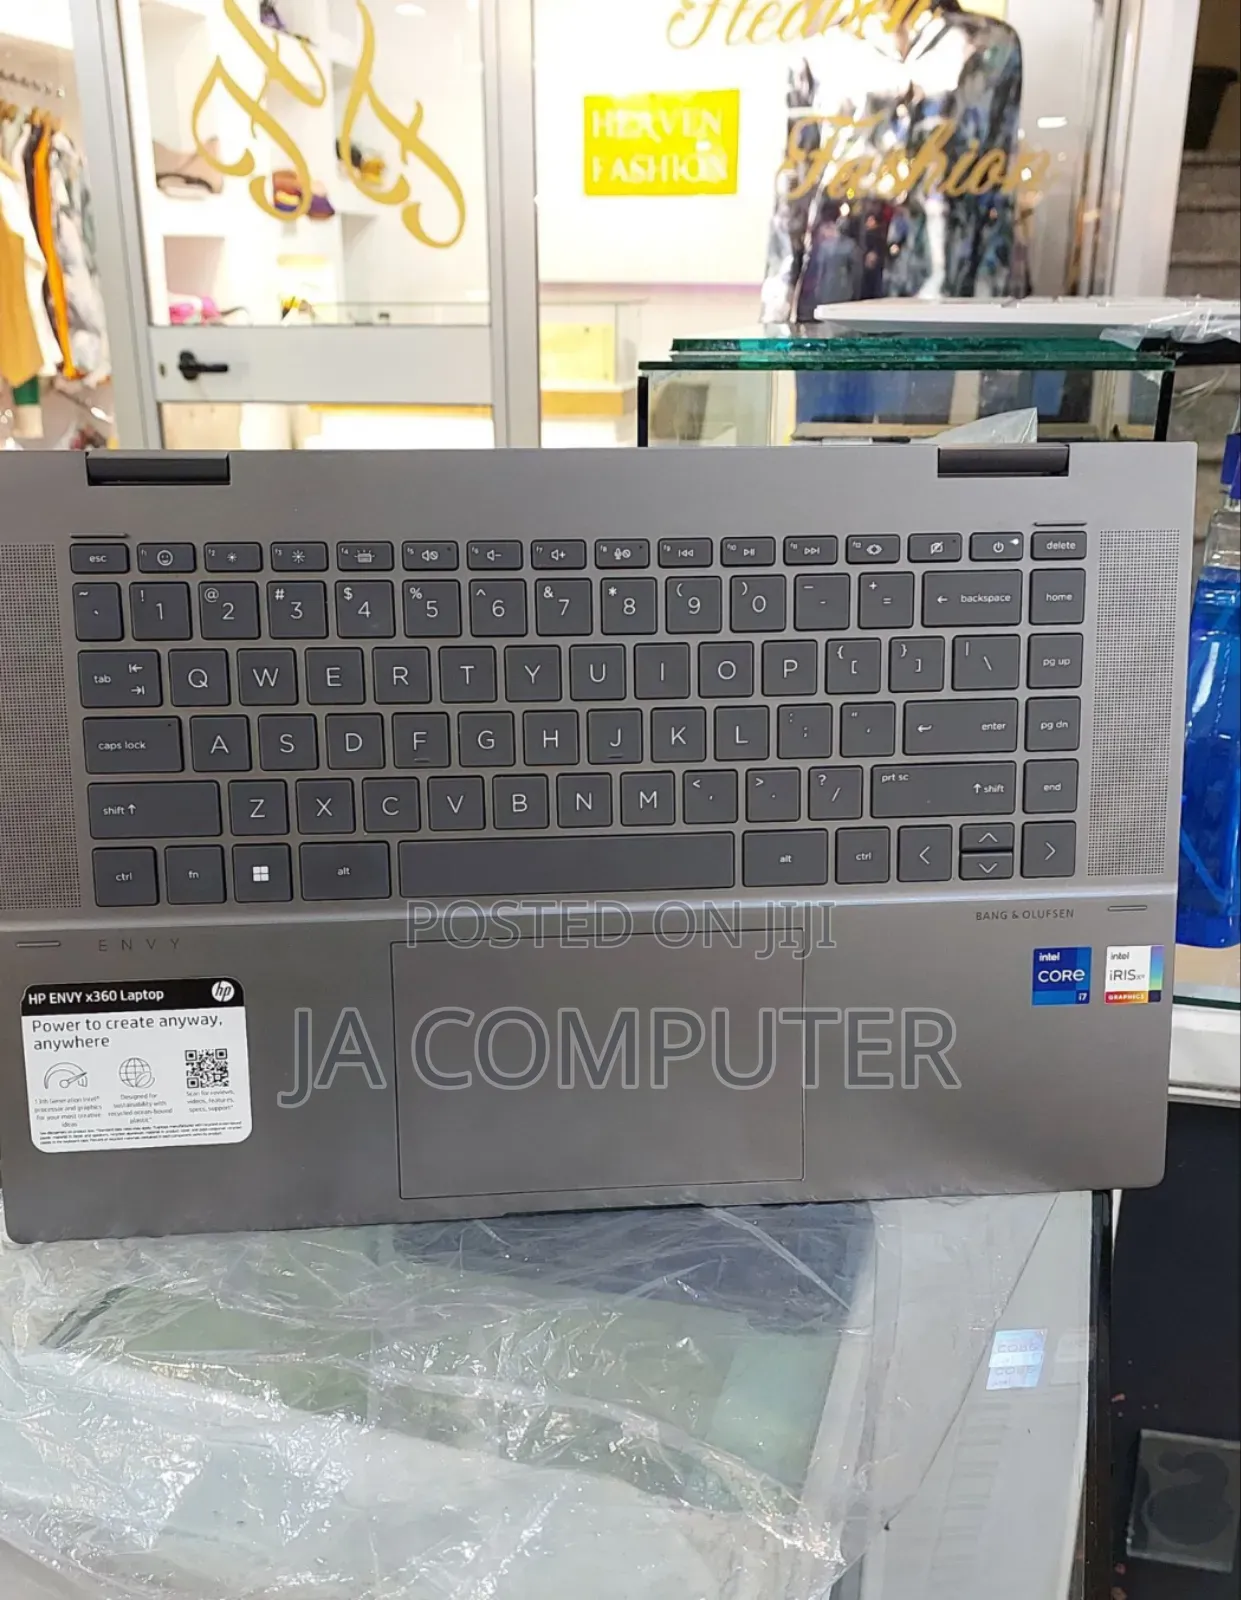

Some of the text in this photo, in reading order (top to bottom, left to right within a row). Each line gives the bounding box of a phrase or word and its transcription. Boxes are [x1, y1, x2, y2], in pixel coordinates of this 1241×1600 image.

[776, 113, 1052, 199] Fashion
[592, 153, 728, 184] FASHION
[1046, 540, 1076, 550] delete
[89, 555, 107, 563] esc
[204, 587, 220, 603] @
[274, 588, 285, 601] #
[343, 586, 353, 601] $
[409, 587, 423, 600] %
[543, 585, 554, 599] &
[676, 582, 683, 597] (
[741, 581, 748, 596] )
[1046, 593, 1073, 602] home
[558, 598, 570, 616] 7
[623, 597, 636, 615] 8
[687, 596, 701, 615] 9
[752, 595, 767, 613] 0
[960, 594, 1011, 603] backspace
[156, 602, 163, 621] 1
[222, 602, 235, 620] 2
[290, 601, 303, 619] 3
[357, 601, 371, 618] 4
[426, 600, 439, 618] 5
[492, 599, 505, 618] 6
[717, 660, 737, 680] O
[783, 659, 798, 678] P
[1042, 658, 1071, 667] pg up
[93, 674, 112, 684] tab
[187, 668, 209, 688] Q
[252, 667, 279, 687] W
[326, 667, 342, 687] E
[393, 666, 409, 686] R
[459, 665, 475, 685] T
[524, 665, 541, 684] Y
[589, 663, 606, 683] U
[735, 725, 748, 744] L
[981, 722, 1006, 731] enter
[1040, 720, 1069, 731] pg dn
[210, 735, 229, 754] A
[279, 733, 295, 753] S
[345, 732, 363, 752] D
[413, 731, 427, 751] F
[477, 730, 495, 750] G
[543, 729, 559, 748] H
[609, 728, 621, 747] J
[671, 726, 687, 745] K
[98, 741, 146, 751] caps lock
[881, 773, 896, 783] prt
[983, 783, 1005, 793] shift
[1043, 783, 1062, 792] end
[250, 798, 266, 818] Z
[316, 797, 333, 817] X
[382, 796, 399, 816] C
[446, 795, 464, 814] V
[512, 793, 528, 813] B
[576, 792, 592, 811] N
[639, 790, 658, 809] M
[102, 806, 126, 816] shift
[779, 855, 792, 863] alt
[855, 852, 872, 861] ctrl
[115, 872, 133, 882] ctrl
[188, 870, 199, 879] fn
[337, 866, 351, 876] alt
[976, 909, 1074, 921] BANG & OLUFSEN
[98, 938, 180, 951] ENVY
[1039, 952, 1060, 961] intel
[1111, 952, 1129, 960] intel
[28, 990, 164, 1004] HP ENVY x360 Laptop
[214, 983, 232, 1000] hp
[1079, 993, 1087, 1001] i7
[32, 1014, 223, 1032] Power to create anyway,
[34, 1037, 110, 1051] anywhere
[108, 1109, 133, 1117] recycled
